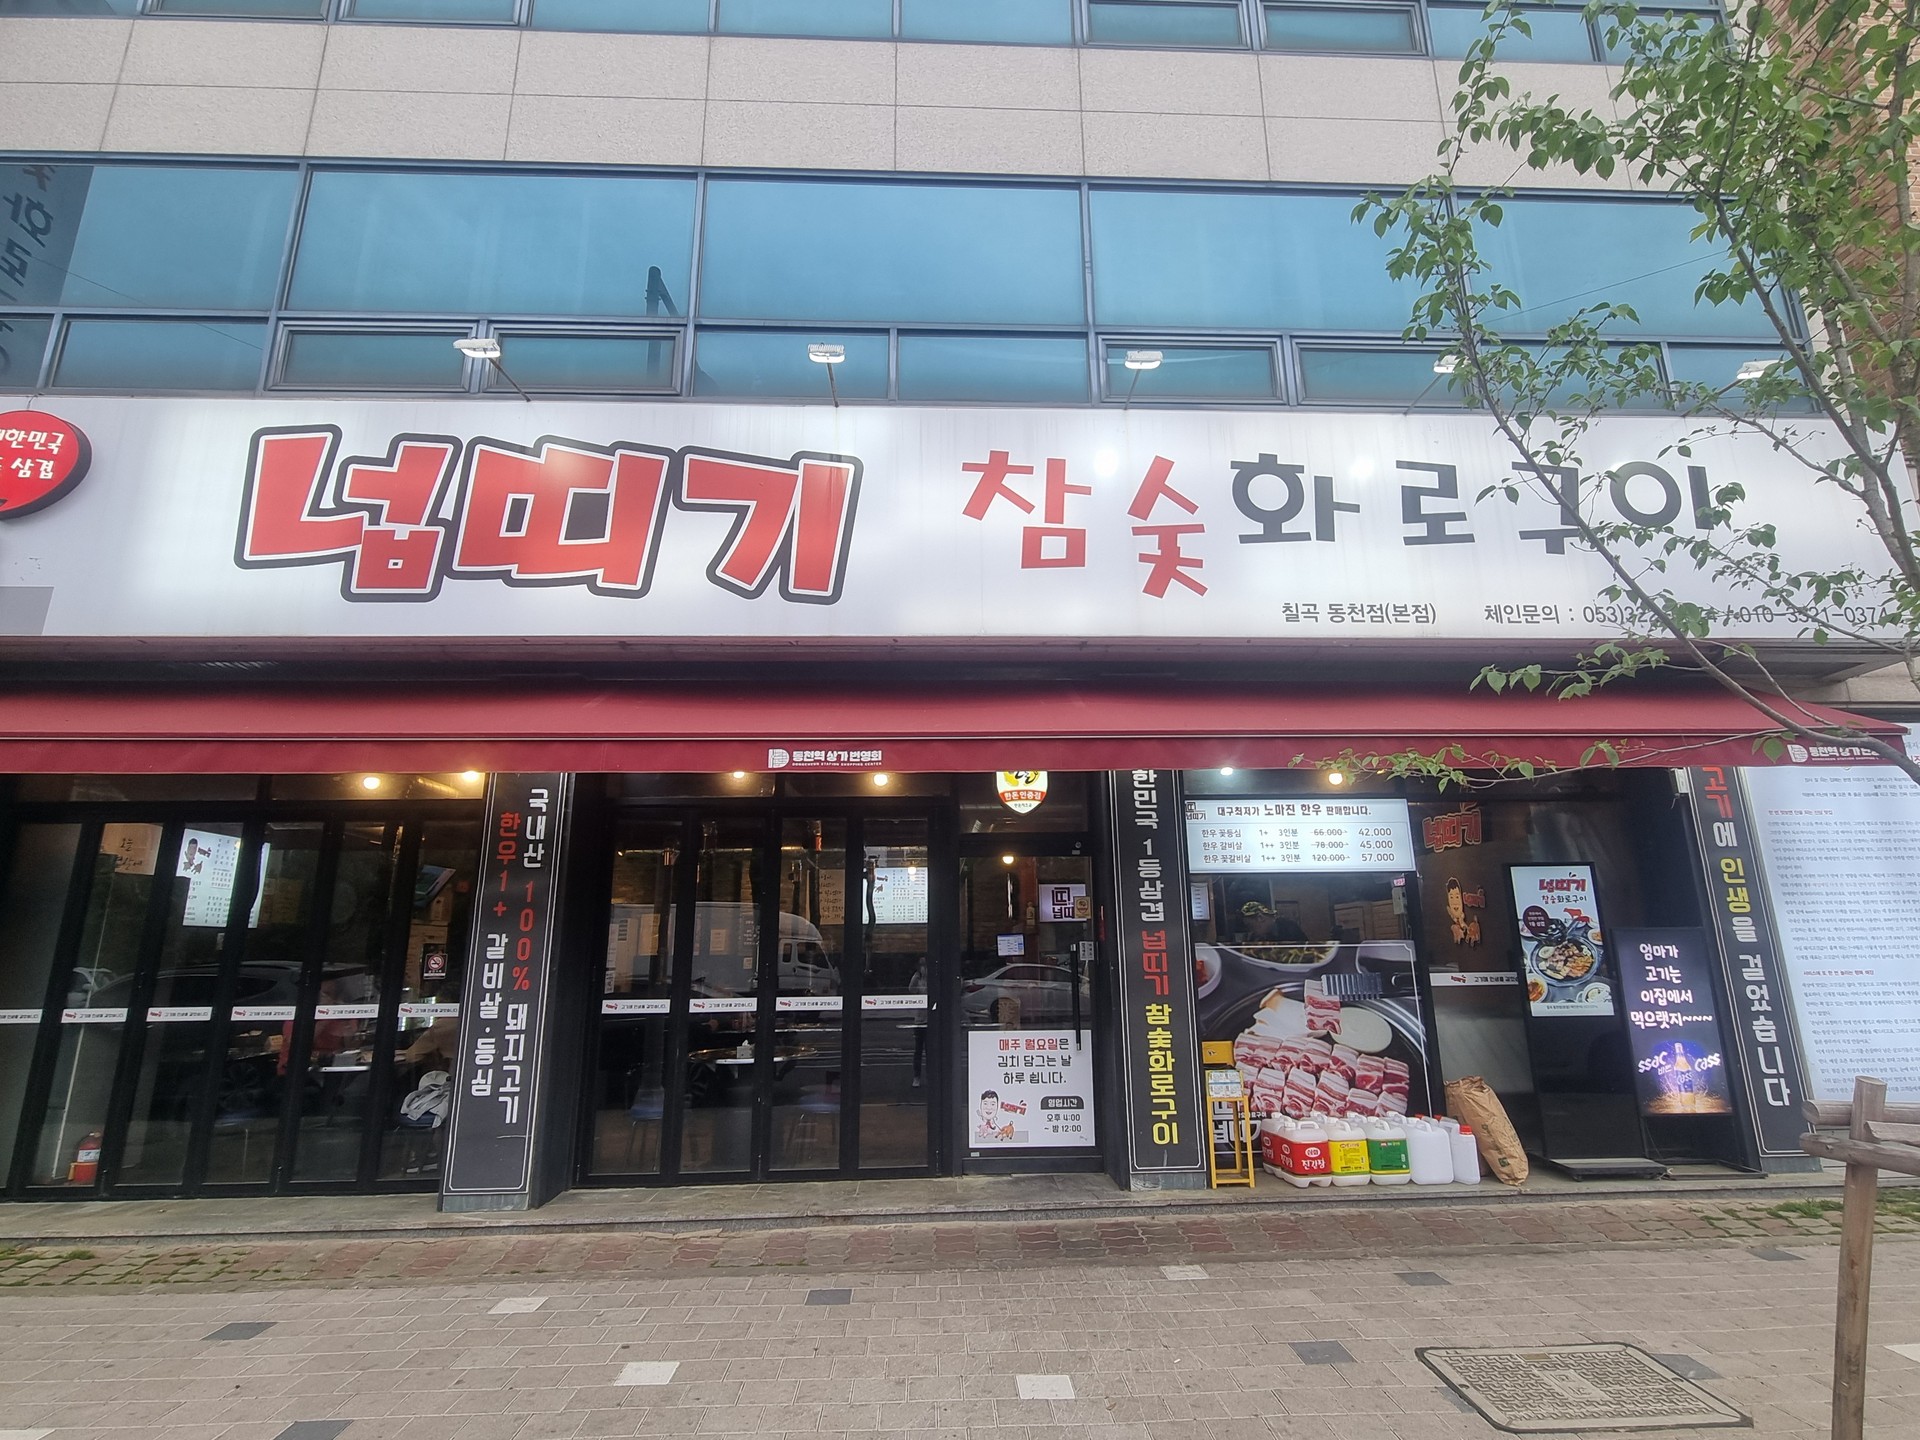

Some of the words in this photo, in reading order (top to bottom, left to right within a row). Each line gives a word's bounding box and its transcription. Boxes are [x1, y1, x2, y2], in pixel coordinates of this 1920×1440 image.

[10, 458, 54, 479] 삼겹
[235, 424, 864, 604] 넙띠기
[1282, 602, 1320, 624] 칠곡
[1327, 602, 1437, 624] 동천점(본점)
[1484, 604, 1560, 624] 체인문의
[792, 750, 825, 762] 동천역
[826, 750, 848, 762] 상가
[850, 750, 882, 762] 번영회
[1217, 806, 1260, 817] 대구최저가
[1263, 804, 1296, 816] 노마진
[1300, 804, 1322, 816] 한우
[1326, 805, 1372, 817] 판매합니다.
[523, 789, 549, 868] 국내산
[1201, 829, 1216, 837] 한우
[1218, 828, 1241, 838] 꽃등심
[1278, 828, 1298, 837] 3인분
[1202, 842, 1217, 850] 한우
[1219, 841, 1242, 850] 갈비살
[1279, 841, 1300, 850] 3인분
[1203, 854, 1219, 863] 한우
[1220, 854, 1251, 864] 꽃갈비살
[1281, 854, 1301, 862] 3인분
[512, 880, 535, 990] 100%
[1702, 767, 1738, 847] 고기에
[1720, 858, 1757, 943] 인생을
[1739, 954, 1792, 1106] 걸었습니다
[1639, 943, 1679, 961] 엄마가
[1141, 930, 1169, 995] 넙띠기
[1645, 966, 1682, 984] 고기는
[1641, 988, 1693, 1006] 이집에서
[998, 1038, 1021, 1051] 매주
[1025, 1038, 1069, 1051] 월요일은
[498, 1003, 528, 1124] 돼지고기
[998, 1055, 1019, 1067] 김치
[1023, 1055, 1057, 1067] 담그는
[1061, 1055, 1071, 1067] 날
[1003, 1072, 1025, 1084] 하루
[1029, 1071, 1067, 1084] 쉽니다.
[1145, 1003, 1179, 1145] 참숯화로구이
[1048, 1099, 1077, 1107] 영업시간
[1046, 1113, 1061, 1122] 오후
[1063, 1113, 1080, 1122] 4:00
[1052, 1124, 1059, 1133] 밤
[1061, 1124, 1081, 1132] 12:00
